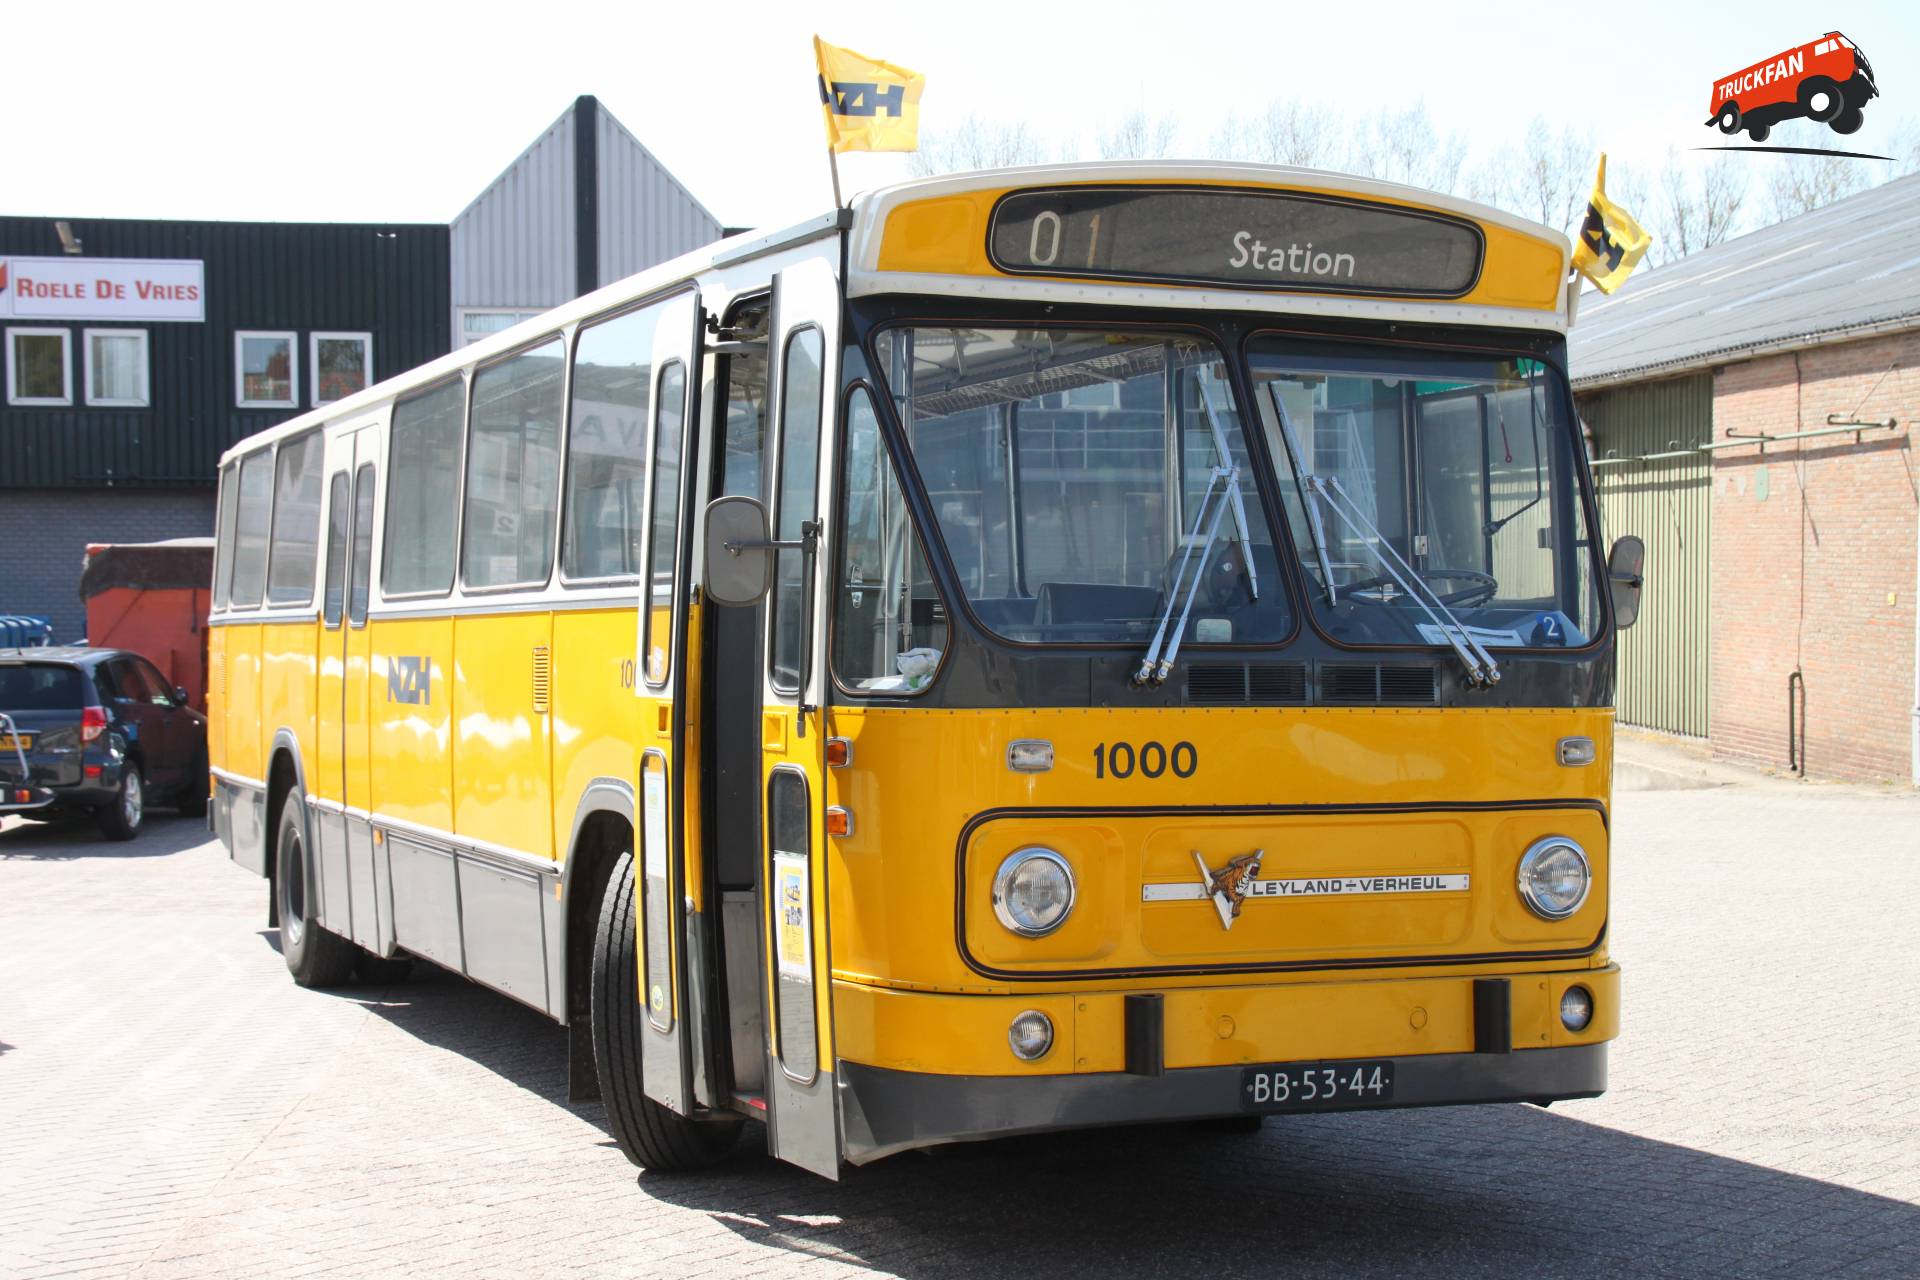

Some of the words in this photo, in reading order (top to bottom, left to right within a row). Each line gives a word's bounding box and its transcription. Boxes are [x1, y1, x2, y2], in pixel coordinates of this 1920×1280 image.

[1029, 210, 1062, 266] 0
[1229, 231, 1356, 278] Station
[16, 277, 86, 298] ROELE
[95, 279, 126, 299] DE
[135, 280, 199, 301] VRIES
[1543, 616, 1559, 636] 2
[387, 656, 431, 705] NZH
[1093, 741, 1198, 778] 1000
